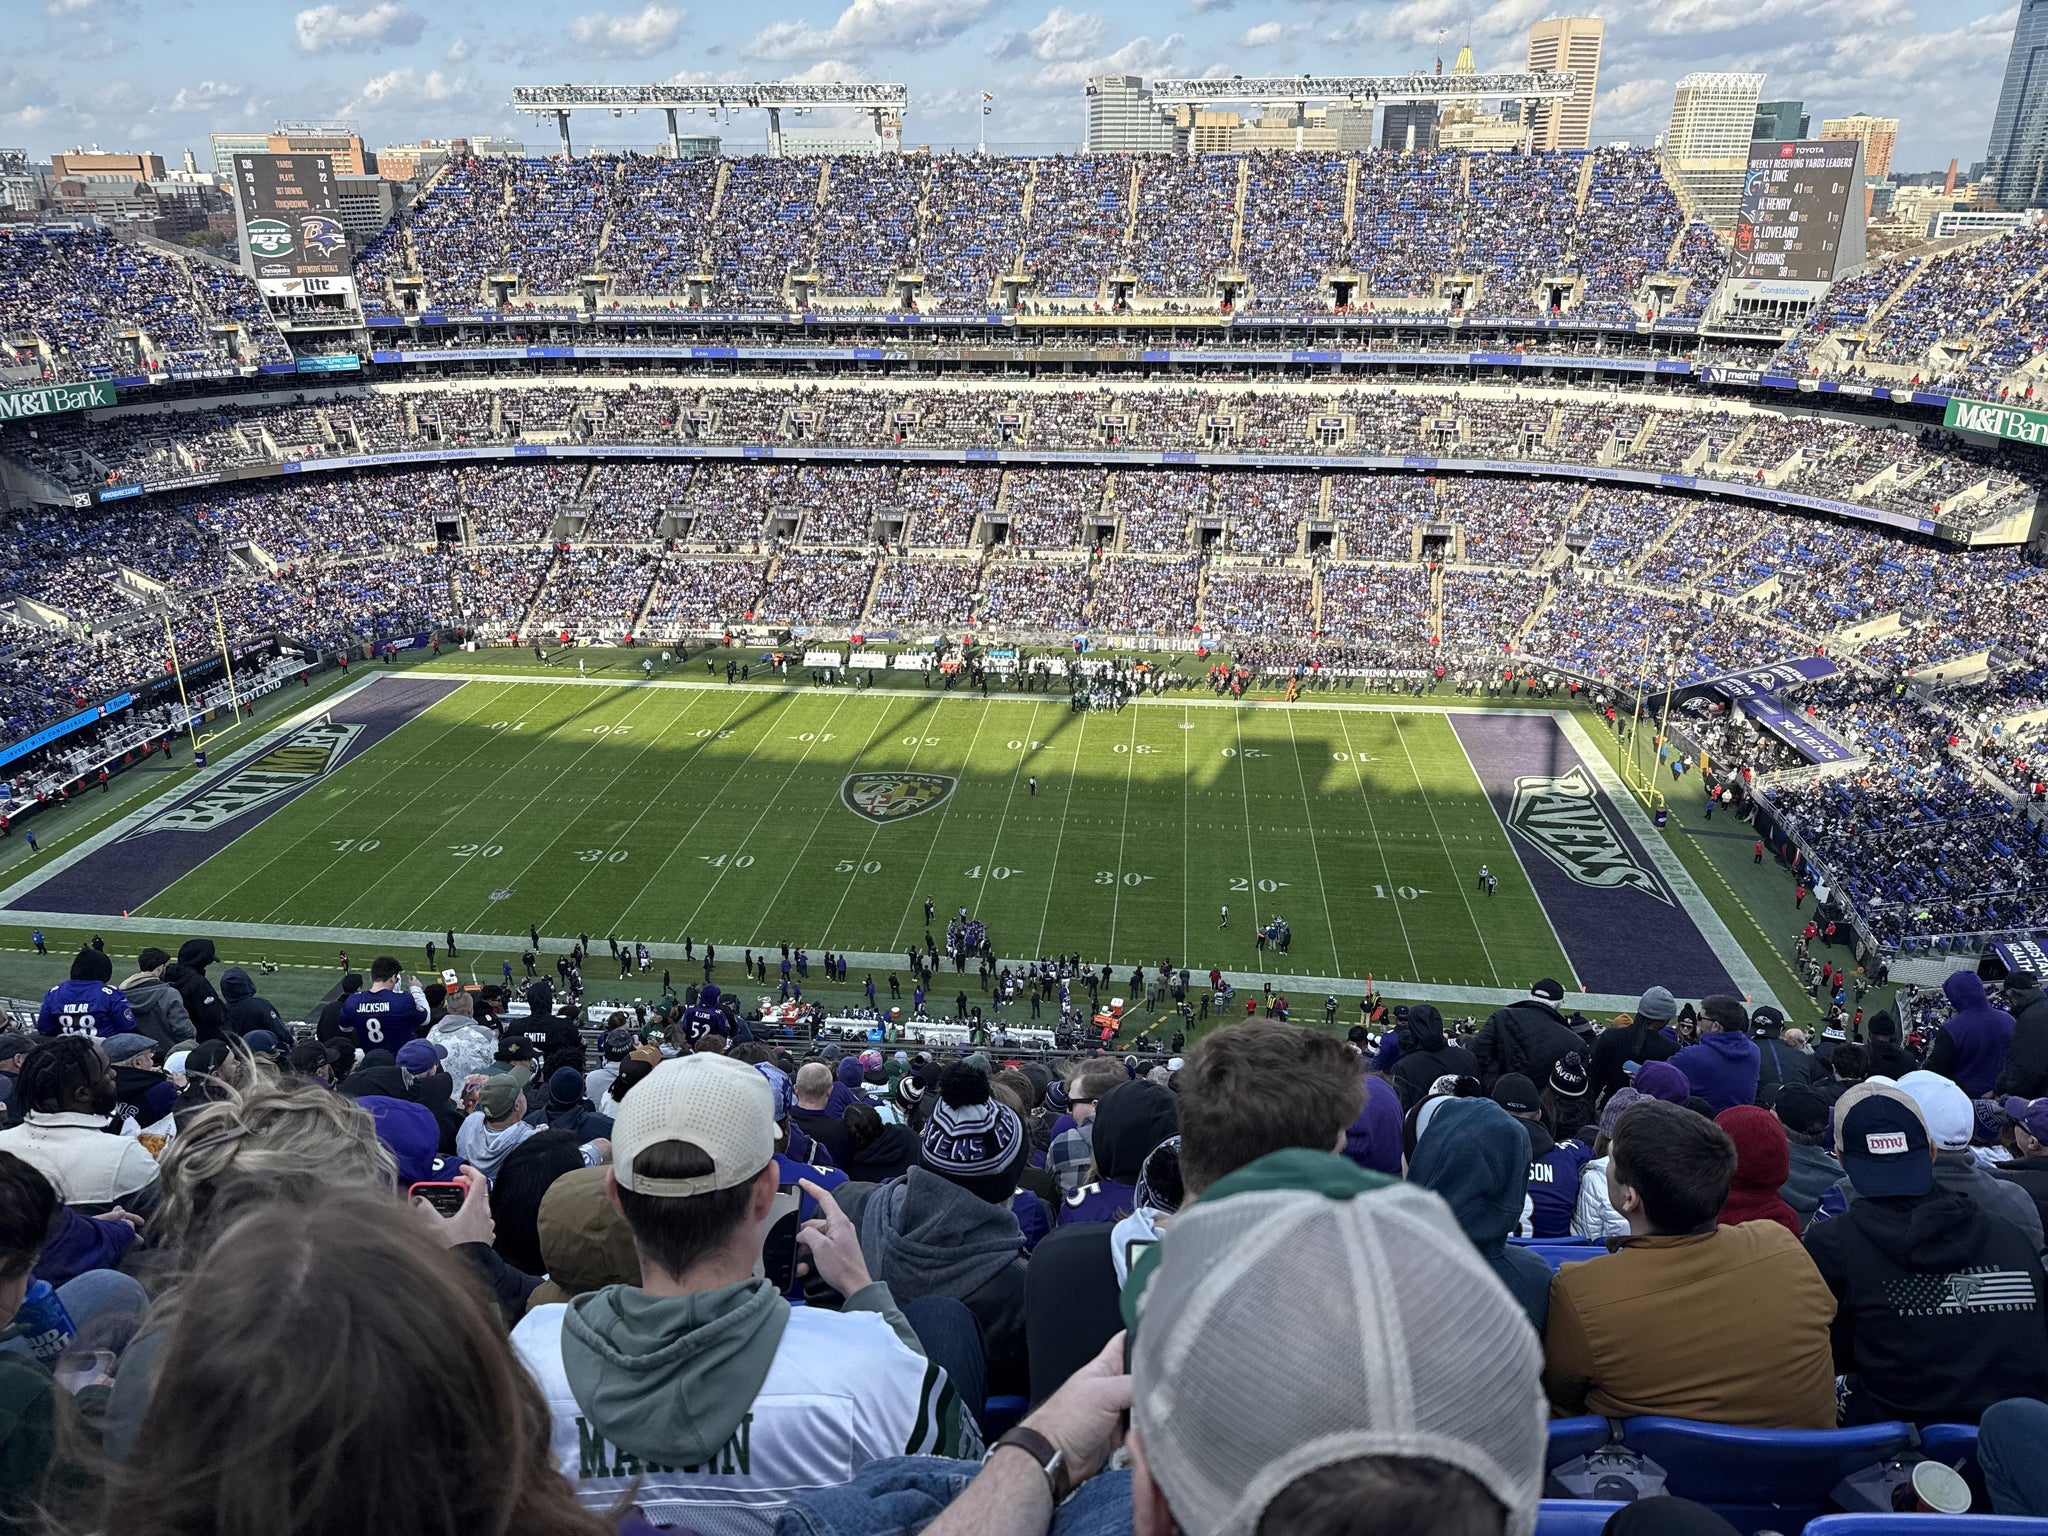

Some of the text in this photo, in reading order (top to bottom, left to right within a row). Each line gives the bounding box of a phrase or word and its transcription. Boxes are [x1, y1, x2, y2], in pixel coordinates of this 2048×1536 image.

[276, 160, 293, 169] YARDS
[316, 159, 326, 169] 73
[1751, 157, 1853, 169] WEEKLY RECEIVING YARDS LEADERS
[278, 173, 295, 182] PLAYS
[319, 172, 328, 182] 22
[1771, 170, 1789, 182] DIKE
[284, 187, 303, 195] DOWNS
[323, 185, 328, 195] 4
[1764, 183, 1770, 194] 3
[1793, 183, 1803, 193] 41
[252, 199, 257, 209] 1
[274, 200, 309, 209] TOUCHDOWNS
[1766, 198, 1792, 210] HENRY
[1759, 211, 1765, 222] 2
[1789, 211, 1798, 222] 40
[1828, 211, 1832, 222] 1
[1761, 226, 1799, 239] LOVELAND
[1754, 239, 1760, 249] 3
[1783, 239, 1793, 250] 38
[1822, 240, 1826, 251] 1
[1755, 253, 1785, 265] HIGGINS
[297, 265, 320, 273] OFFENSIVE
[1749, 266, 1755, 276] 4
[1778, 266, 1788, 277] 38
[1817, 267, 1821, 278] 1
[302, 278, 330, 294] Lite
[1760, 286, 1809, 295] Constellation
[1727, 371, 1760, 381] merritt
[0, 384, 107, 419] M&T Bank
[1954, 402, 2048, 444] M&T Ban
[348, 457, 369, 465] Game
[371, 454, 406, 464] Changers
[415, 452, 441, 461] Facility
[443, 450, 476, 458] Solutions
[1484, 462, 1506, 470] Game
[1508, 463, 1544, 472] Changers
[1554, 466, 1581, 475] Facility
[1582, 468, 1618, 478] Solutions
[101, 486, 141, 500] PROGRESSIVE
[1744, 488, 1767, 498] Game
[1768, 491, 1805, 504] Changers
[1815, 500, 1842, 512] Facility
[1844, 506, 1879, 519] Solutions
[1106, 636, 1200, 651] HME OF THE FLOCK
[1266, 667, 1428, 678] BALTIOE'S MARCHING RAVENS
[228, 680, 282, 709] MARYLAND
[491, 720, 527, 731] 10
[592, 725, 634, 735] 20
[693, 729, 736, 739] 30
[797, 732, 837, 742] 40
[1779, 719, 1839, 760] RAVENS
[902, 736, 940, 747] 50
[1113, 744, 1152, 754] 30
[1221, 747, 1261, 759] 20
[1333, 752, 1370, 762] 10
[861, 775, 942, 784] RAVENS
[1512, 766, 1670, 897] RAVENS
[336, 839, 381, 853] 10
[456, 844, 504, 858] 20
[580, 849, 629, 864] 30
[710, 854, 755, 869] 40
[835, 859, 882, 875] 50
[964, 865, 1011, 880] 40
[1094, 871, 1143, 887] 30
[1229, 877, 1278, 893] 20
[1372, 884, 1419, 900] 10
[2004, 943, 2035, 972] HEALTH
[63, 1004, 89, 1013] KOLAR
[356, 1002, 389, 1013] JACKSON
[59, 1015, 98, 1037] 88
[366, 1017, 384, 1043] 8
[690, 1021, 711, 1038] 52
[524, 1031, 546, 1042] SMITH
[1554, 1060, 1582, 1083] RAVENS
[1869, 1136, 1903, 1149] DMV
[1899, 1303, 2035, 1317] FALCONS LACROSSE
